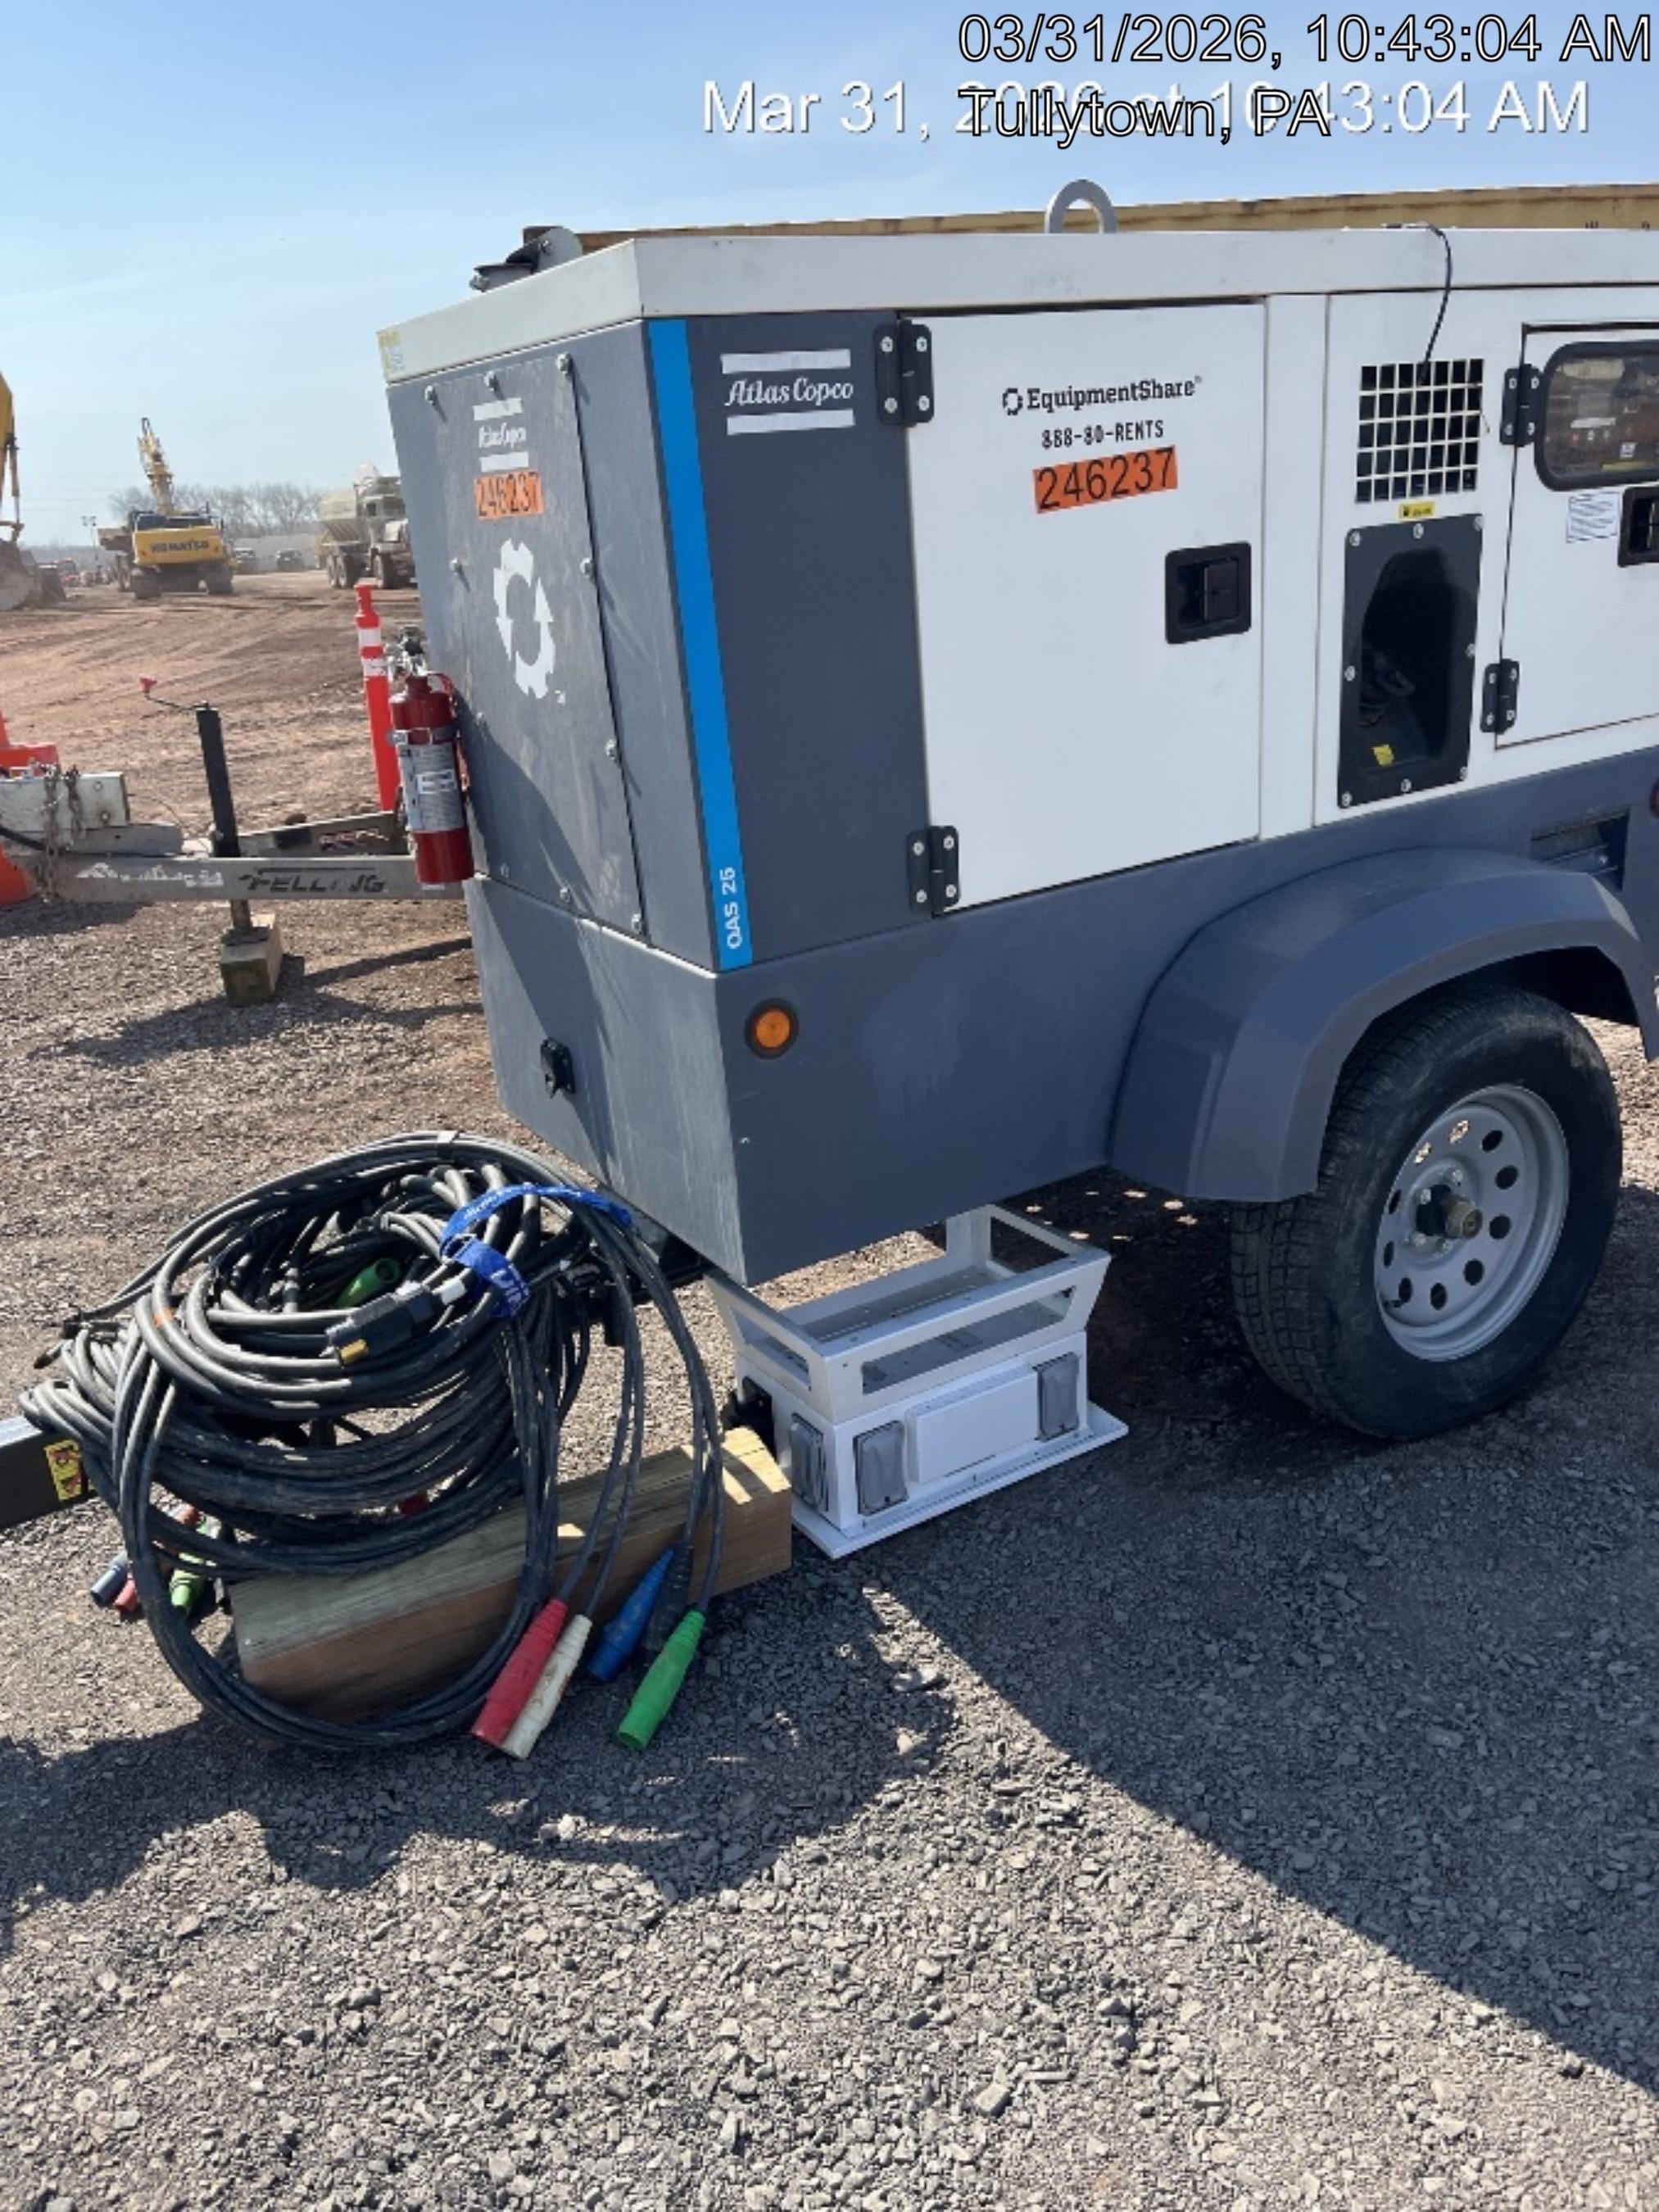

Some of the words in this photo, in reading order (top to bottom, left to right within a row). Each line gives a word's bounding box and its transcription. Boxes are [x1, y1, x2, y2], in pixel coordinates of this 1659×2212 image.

[724, 378, 790, 406] Atlas
[793, 376, 854, 406] Copco
[1027, 378, 1196, 413] EquipmentShare
[1041, 419, 1164, 450] 888-80-RENTS
[475, 471, 540, 517] 246237
[1036, 446, 1174, 510] 246237
[151, 540, 210, 554] KOMATSU
